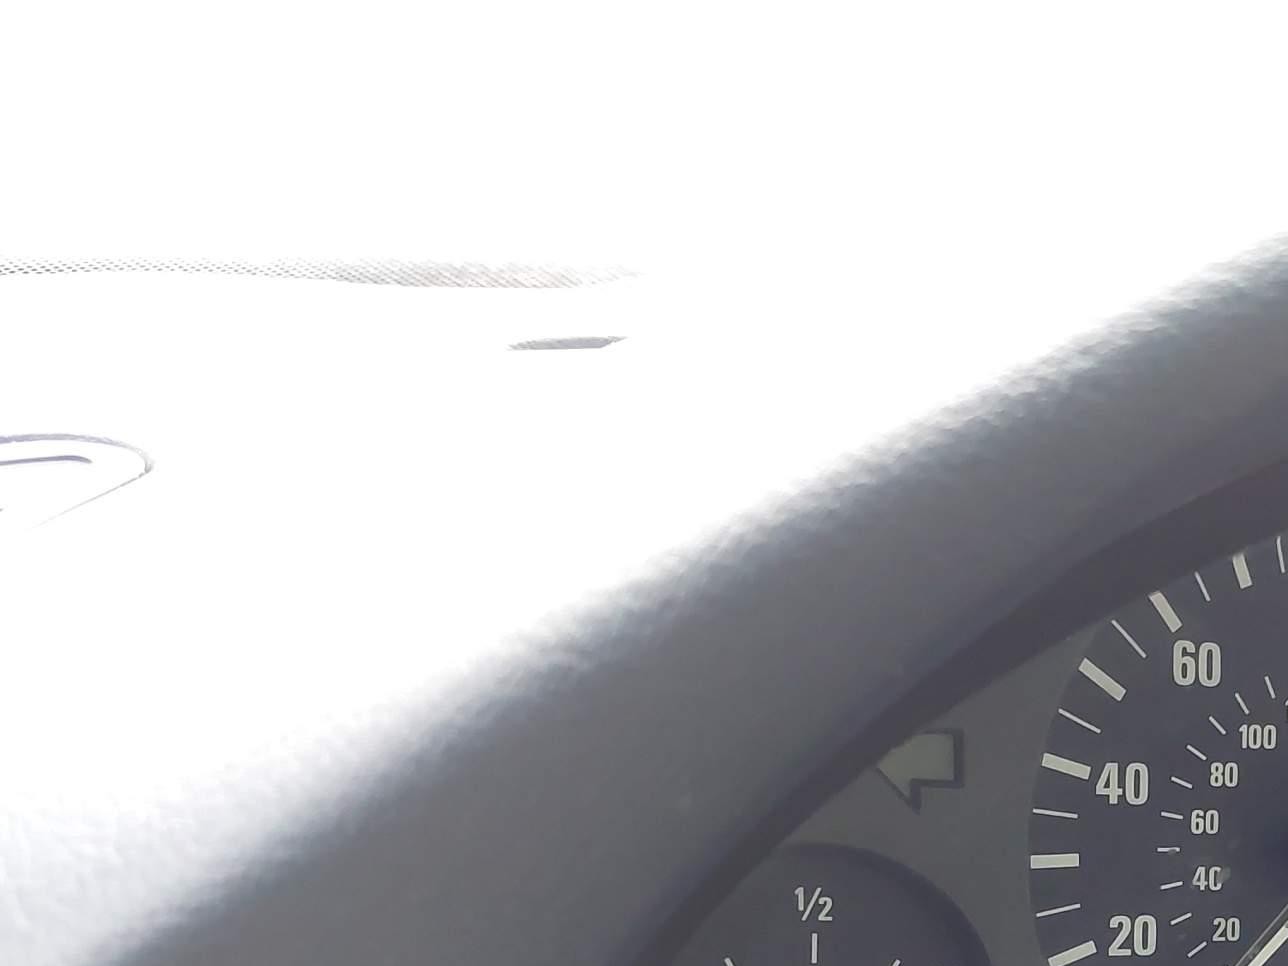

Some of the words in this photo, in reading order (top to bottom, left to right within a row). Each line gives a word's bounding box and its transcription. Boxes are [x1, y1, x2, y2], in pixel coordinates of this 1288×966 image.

[1172, 640, 1222, 687] 60
[1238, 725, 1277, 749] 100
[1095, 763, 1149, 805] 40
[1209, 763, 1239, 788] 80
[1190, 809, 1219, 835] 60
[1192, 866, 1222, 892] 40
[793, 886, 833, 922] 1/2
[1108, 914, 1157, 957] 20
[1212, 917, 1241, 943] 20
